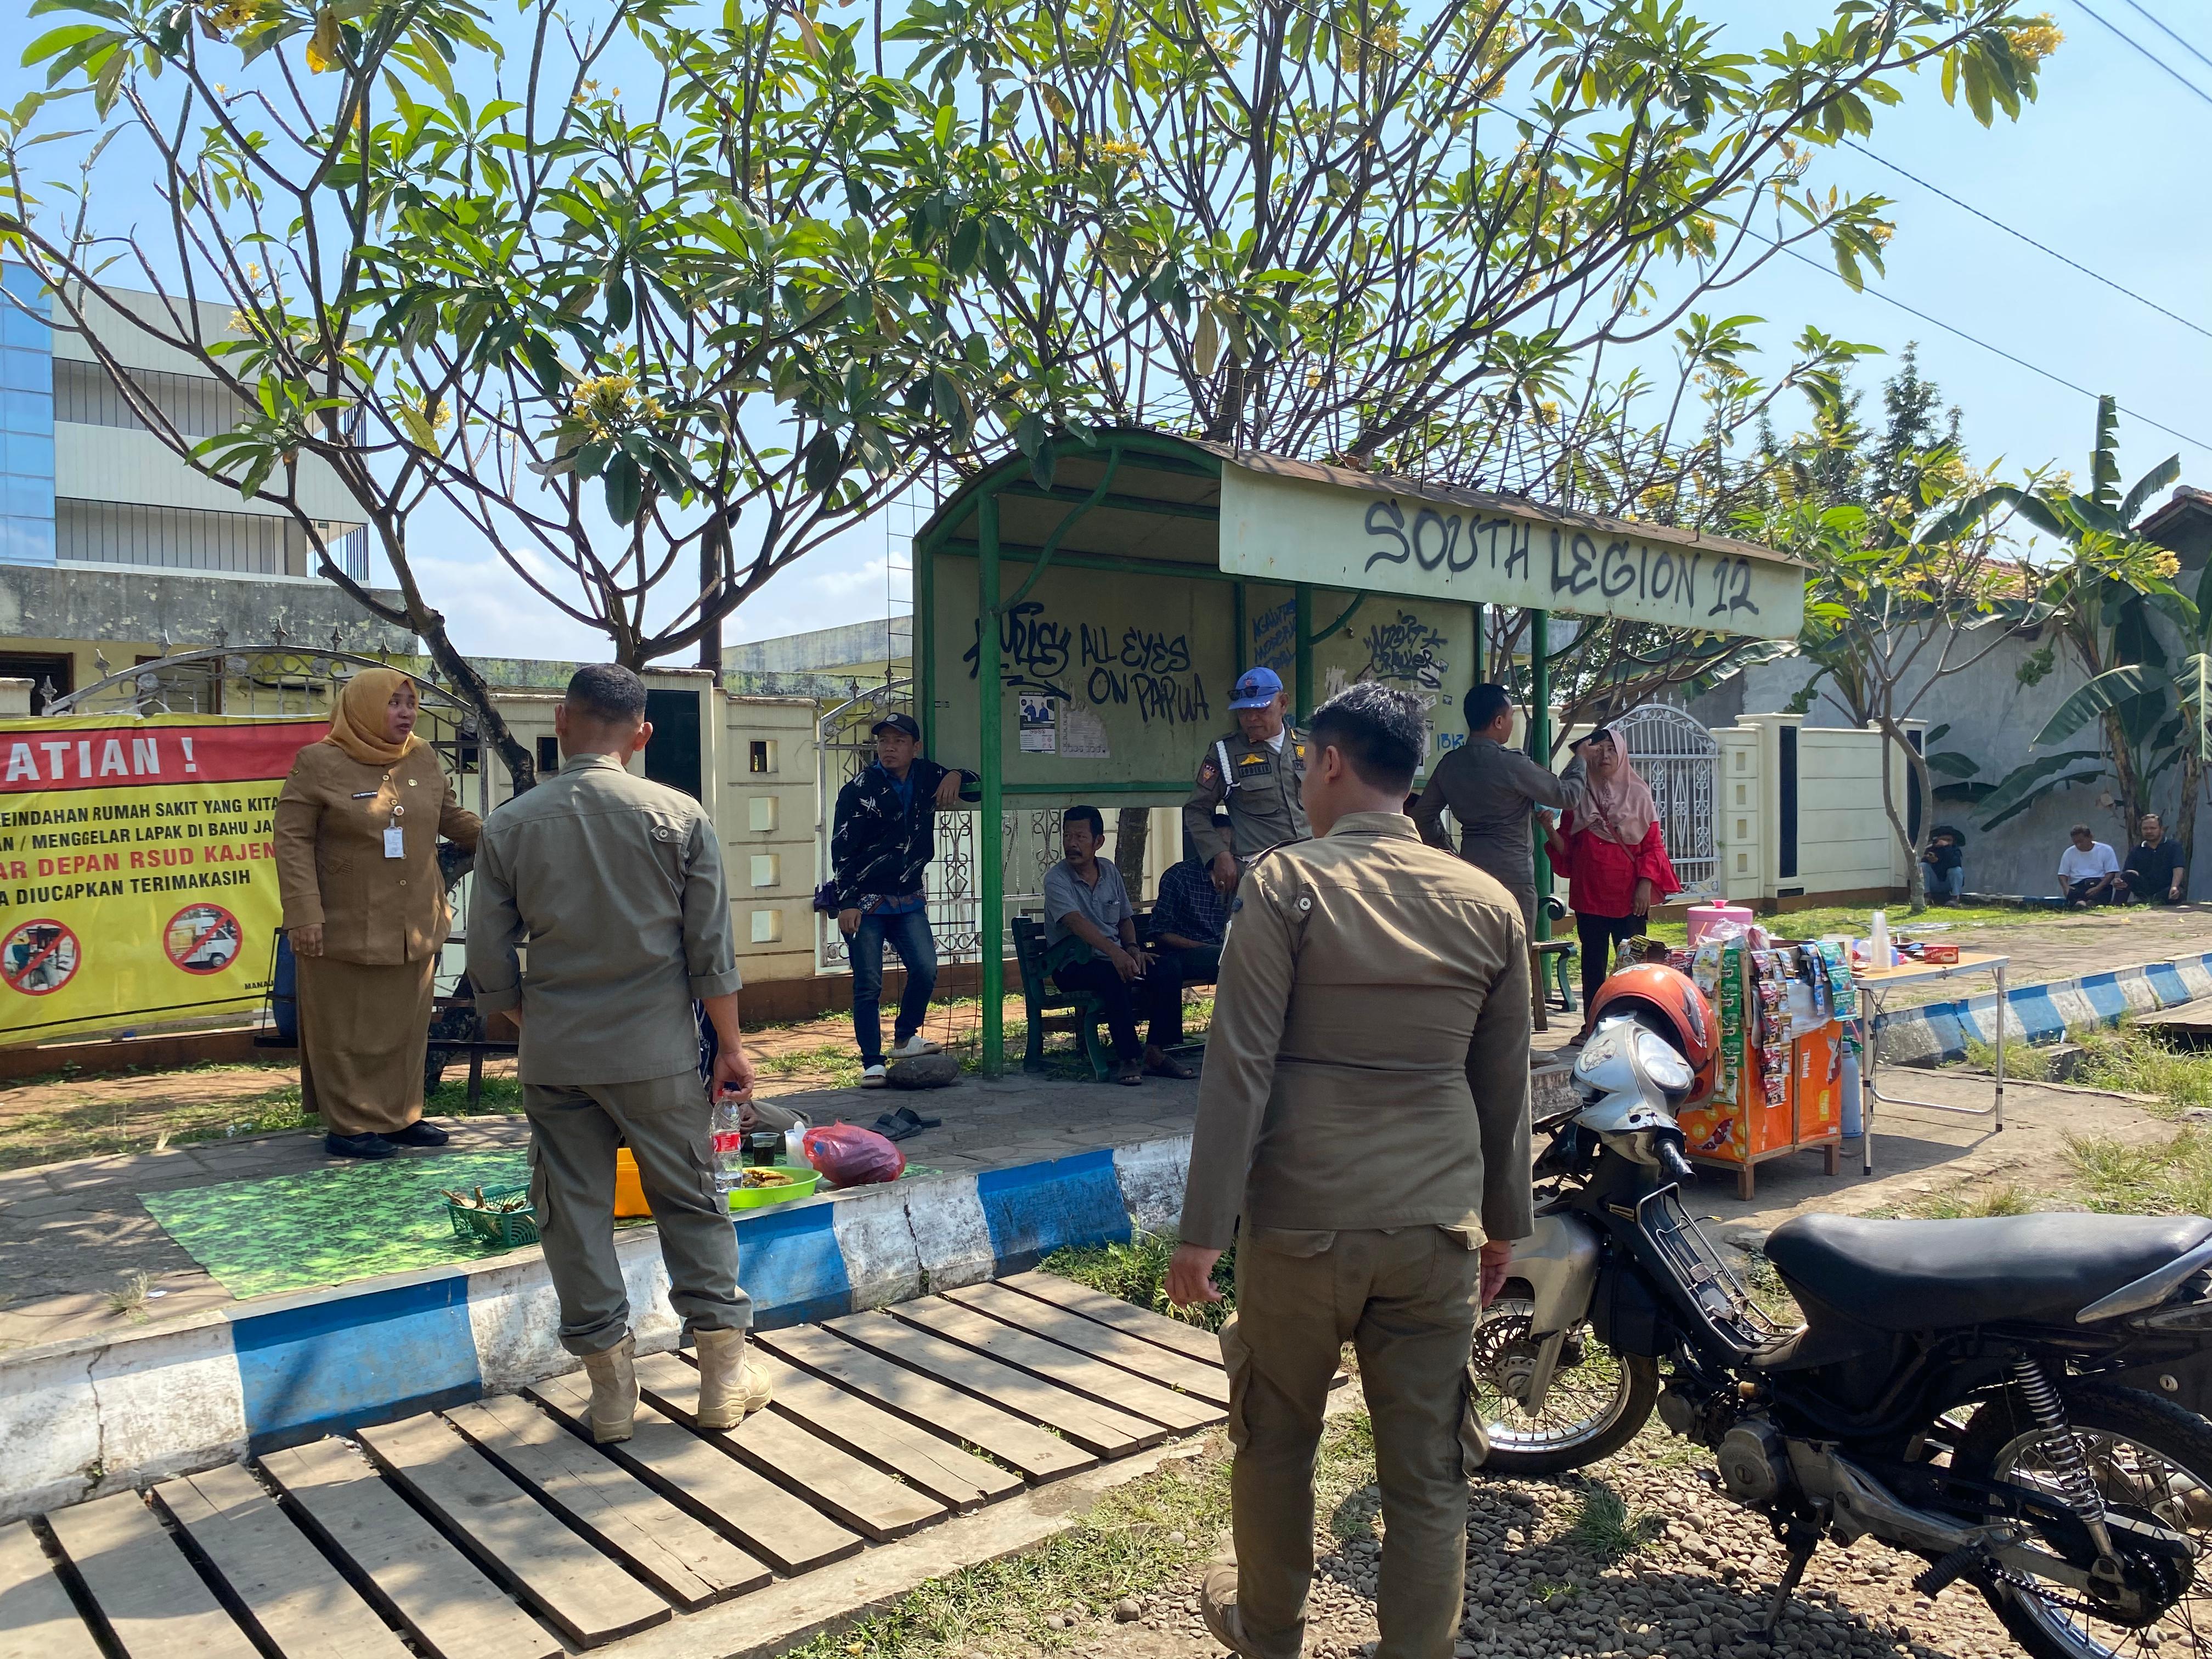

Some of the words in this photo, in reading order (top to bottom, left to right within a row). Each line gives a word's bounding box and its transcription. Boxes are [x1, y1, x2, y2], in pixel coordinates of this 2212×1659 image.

[1364, 499, 1530, 580] SOUTH
[1551, 528, 1701, 611] LEGION
[1707, 557, 1759, 617] 12
[1081, 623, 1116, 667] ALL
[1121, 627, 1191, 674] EYES
[1087, 667, 1127, 704] ON
[1130, 673, 1210, 725] PAPUA
[5, 737, 161, 782] ATIAN
[182, 737, 197, 773] !
[0, 808, 88, 827] EINDAHAN
[93, 804, 150, 821] RUMAH
[156, 800, 198, 817] SAKIT
[202, 799, 242, 814] YANG
[248, 797, 278, 812] KITA
[20, 836, 26, 852] /
[32, 828, 131, 849] MENGGELAR
[136, 826, 182, 841] LAPAK
[188, 823, 203, 838] DI
[208, 821, 248, 836] BAHU
[38, 853, 119, 877] DEPAN
[130, 847, 194, 869] RSUD
[205, 842, 276, 862] KAJEN
[16, 879, 124, 905] DIUCAPKAN
[130, 869, 251, 894] TERIMAKASIH
[1632, 940, 1646, 951] ABC
